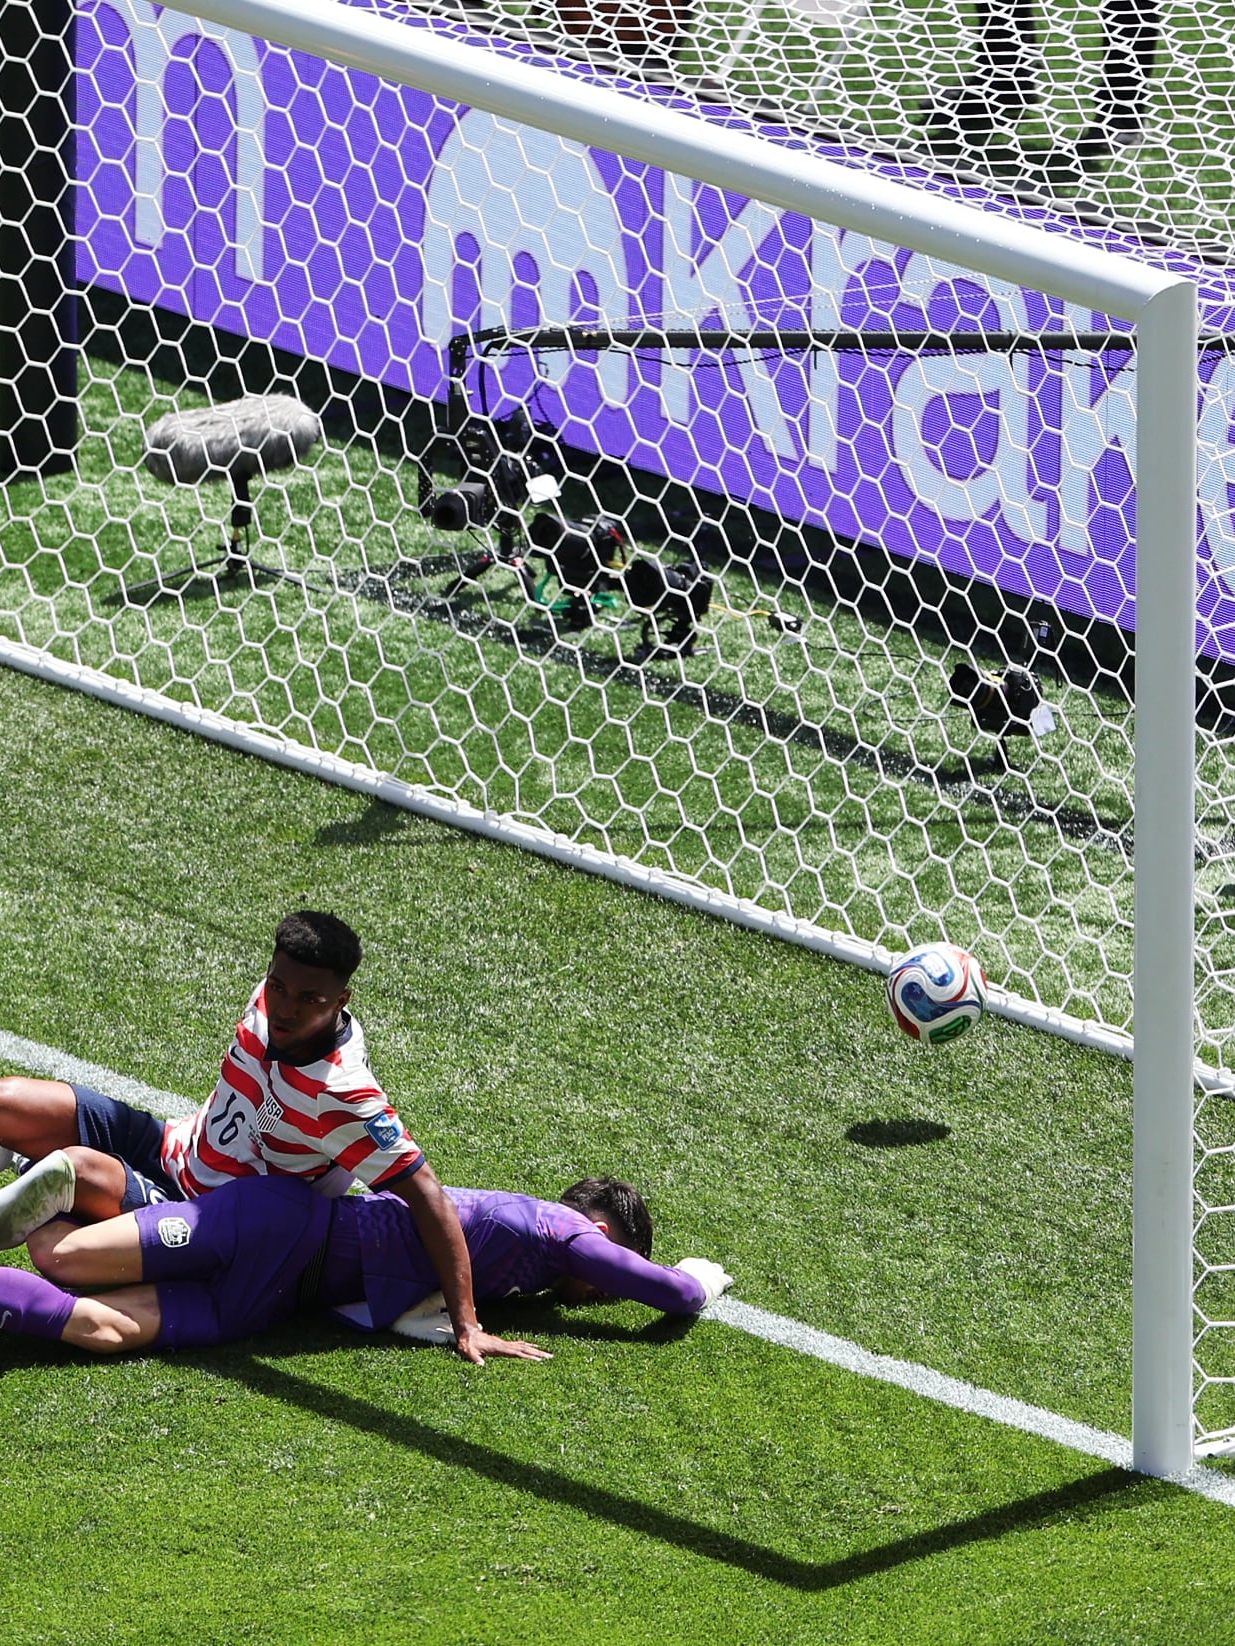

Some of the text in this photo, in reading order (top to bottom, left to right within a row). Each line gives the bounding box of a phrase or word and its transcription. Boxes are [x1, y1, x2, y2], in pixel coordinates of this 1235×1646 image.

[659, 170, 1235, 596] krak
[211, 1091, 246, 1146] 16
[265, 1094, 283, 1119] USA
